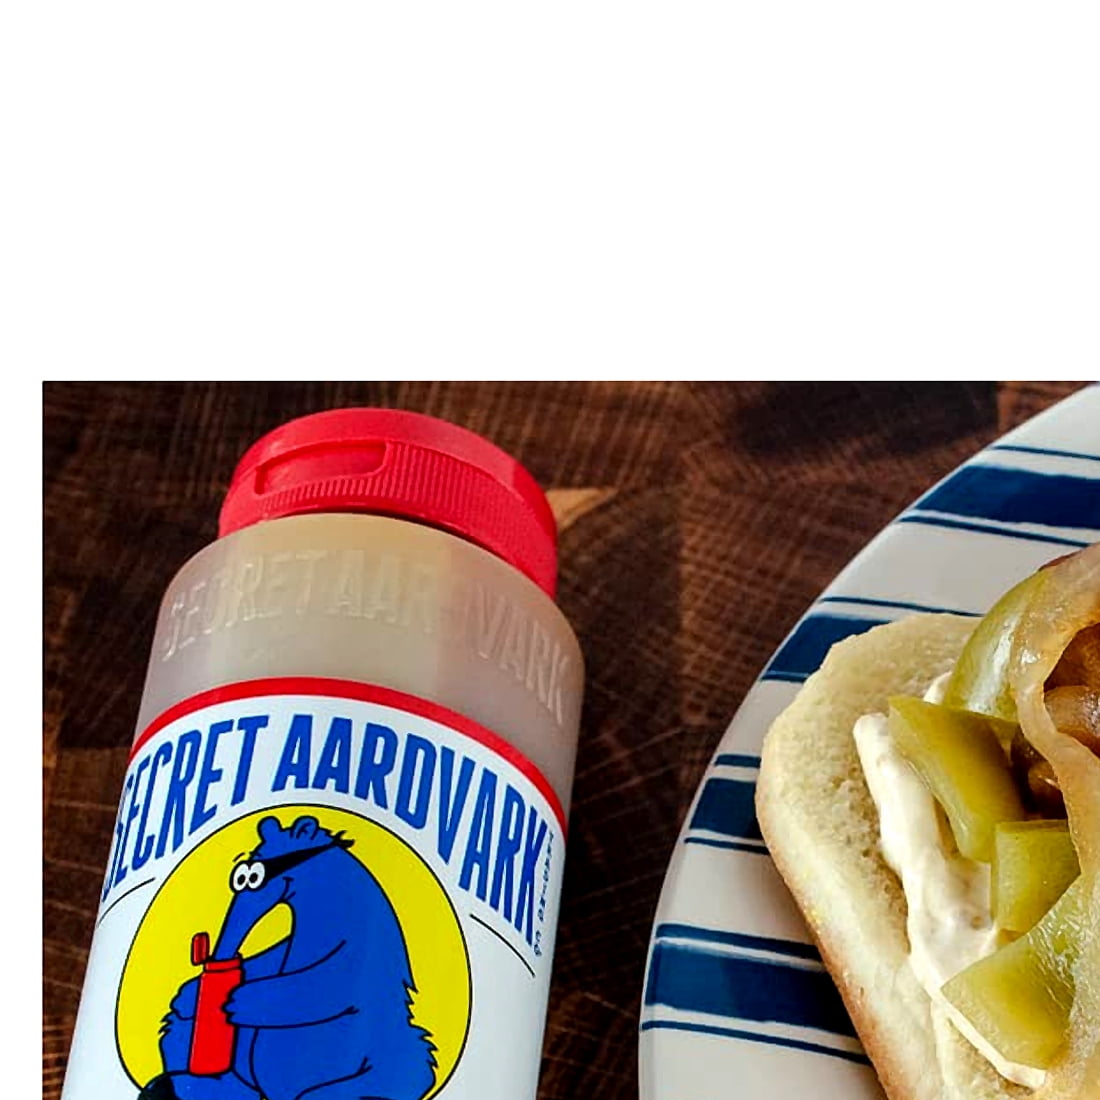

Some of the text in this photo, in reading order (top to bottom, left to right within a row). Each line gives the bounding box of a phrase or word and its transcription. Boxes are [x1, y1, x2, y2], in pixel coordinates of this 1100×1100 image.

[327, 549, 571, 726] AARVARK
[102, 714, 270, 903] SECRET
[271, 713, 548, 947] AARDVARK
